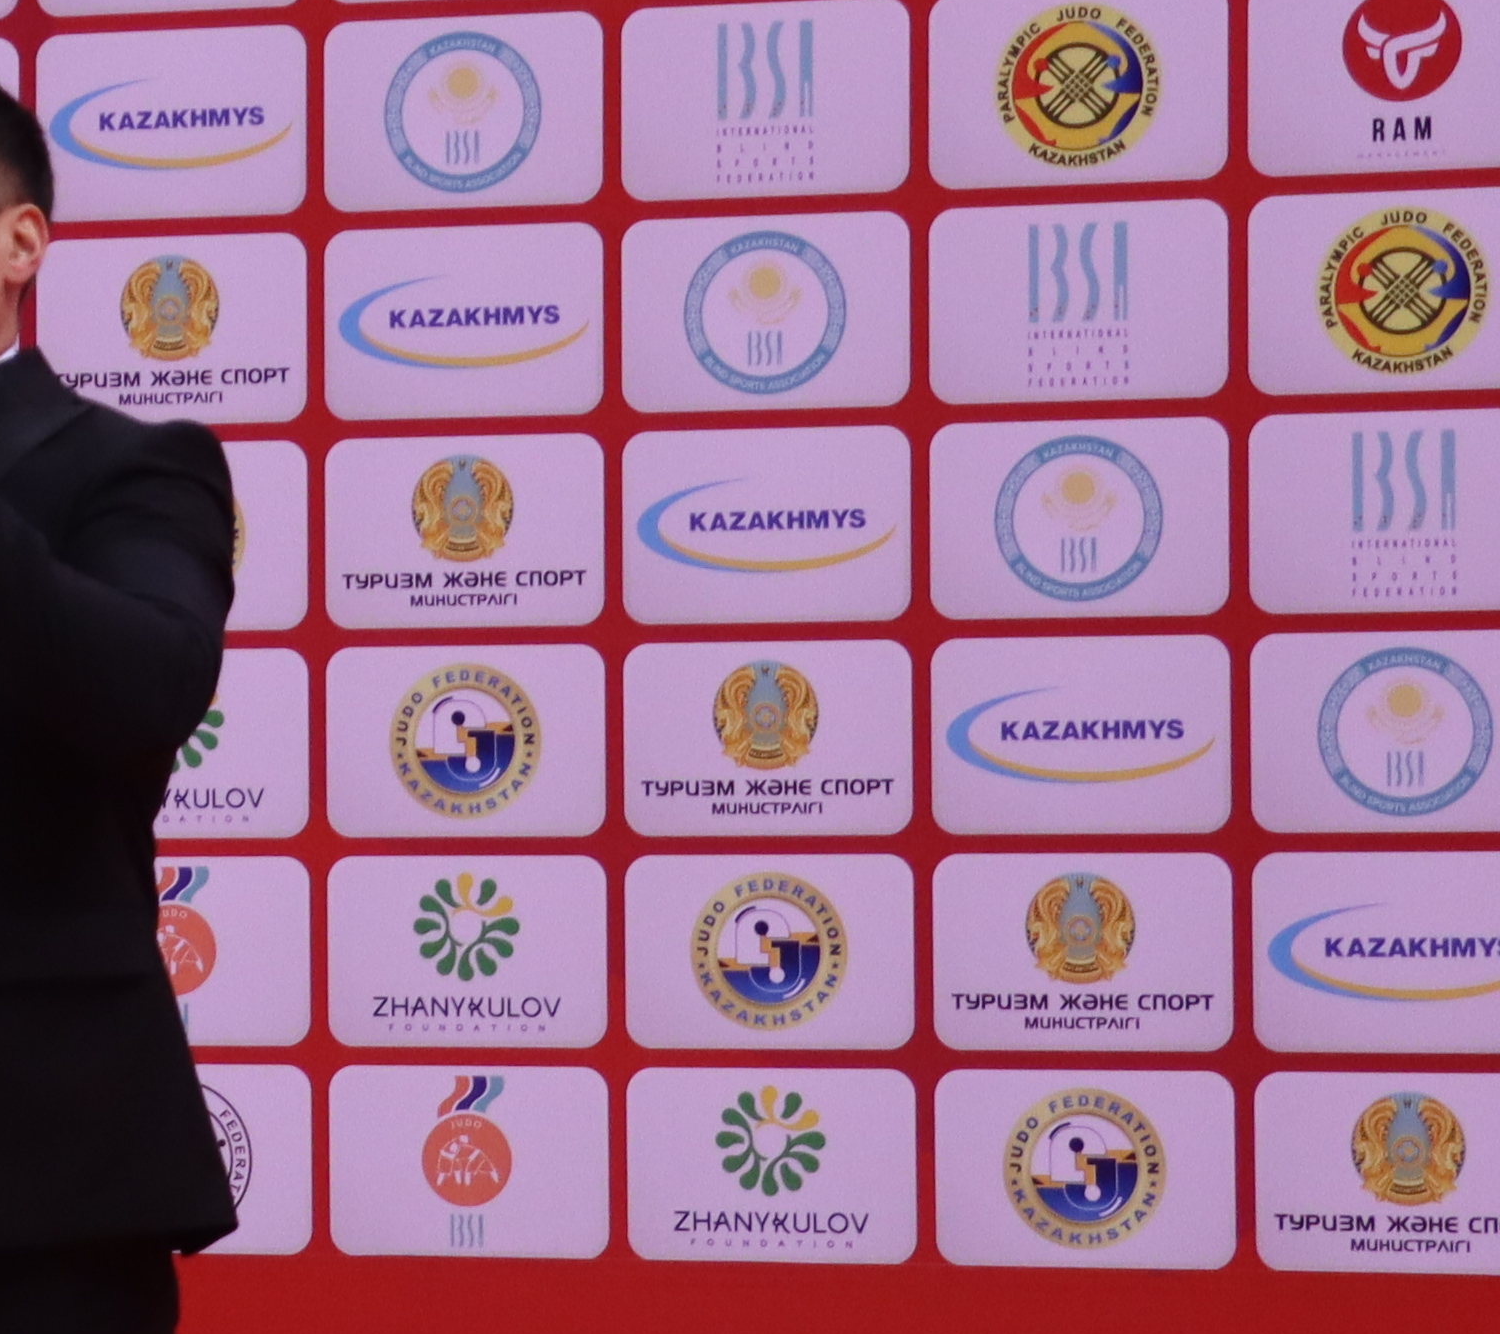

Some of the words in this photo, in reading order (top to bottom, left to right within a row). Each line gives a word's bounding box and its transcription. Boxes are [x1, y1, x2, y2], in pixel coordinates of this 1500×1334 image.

[389, 304, 560, 329] KAZAKHMYS
[1001, 719, 1185, 741] KAZAKHMYS
[733, 876, 845, 957] FEDERATION
[372, 996, 561, 1018] ZHANYKULOV
[697, 971, 840, 1025] KAZAKHSTAN
[673, 1210, 869, 1235] ZHANYKULOV
